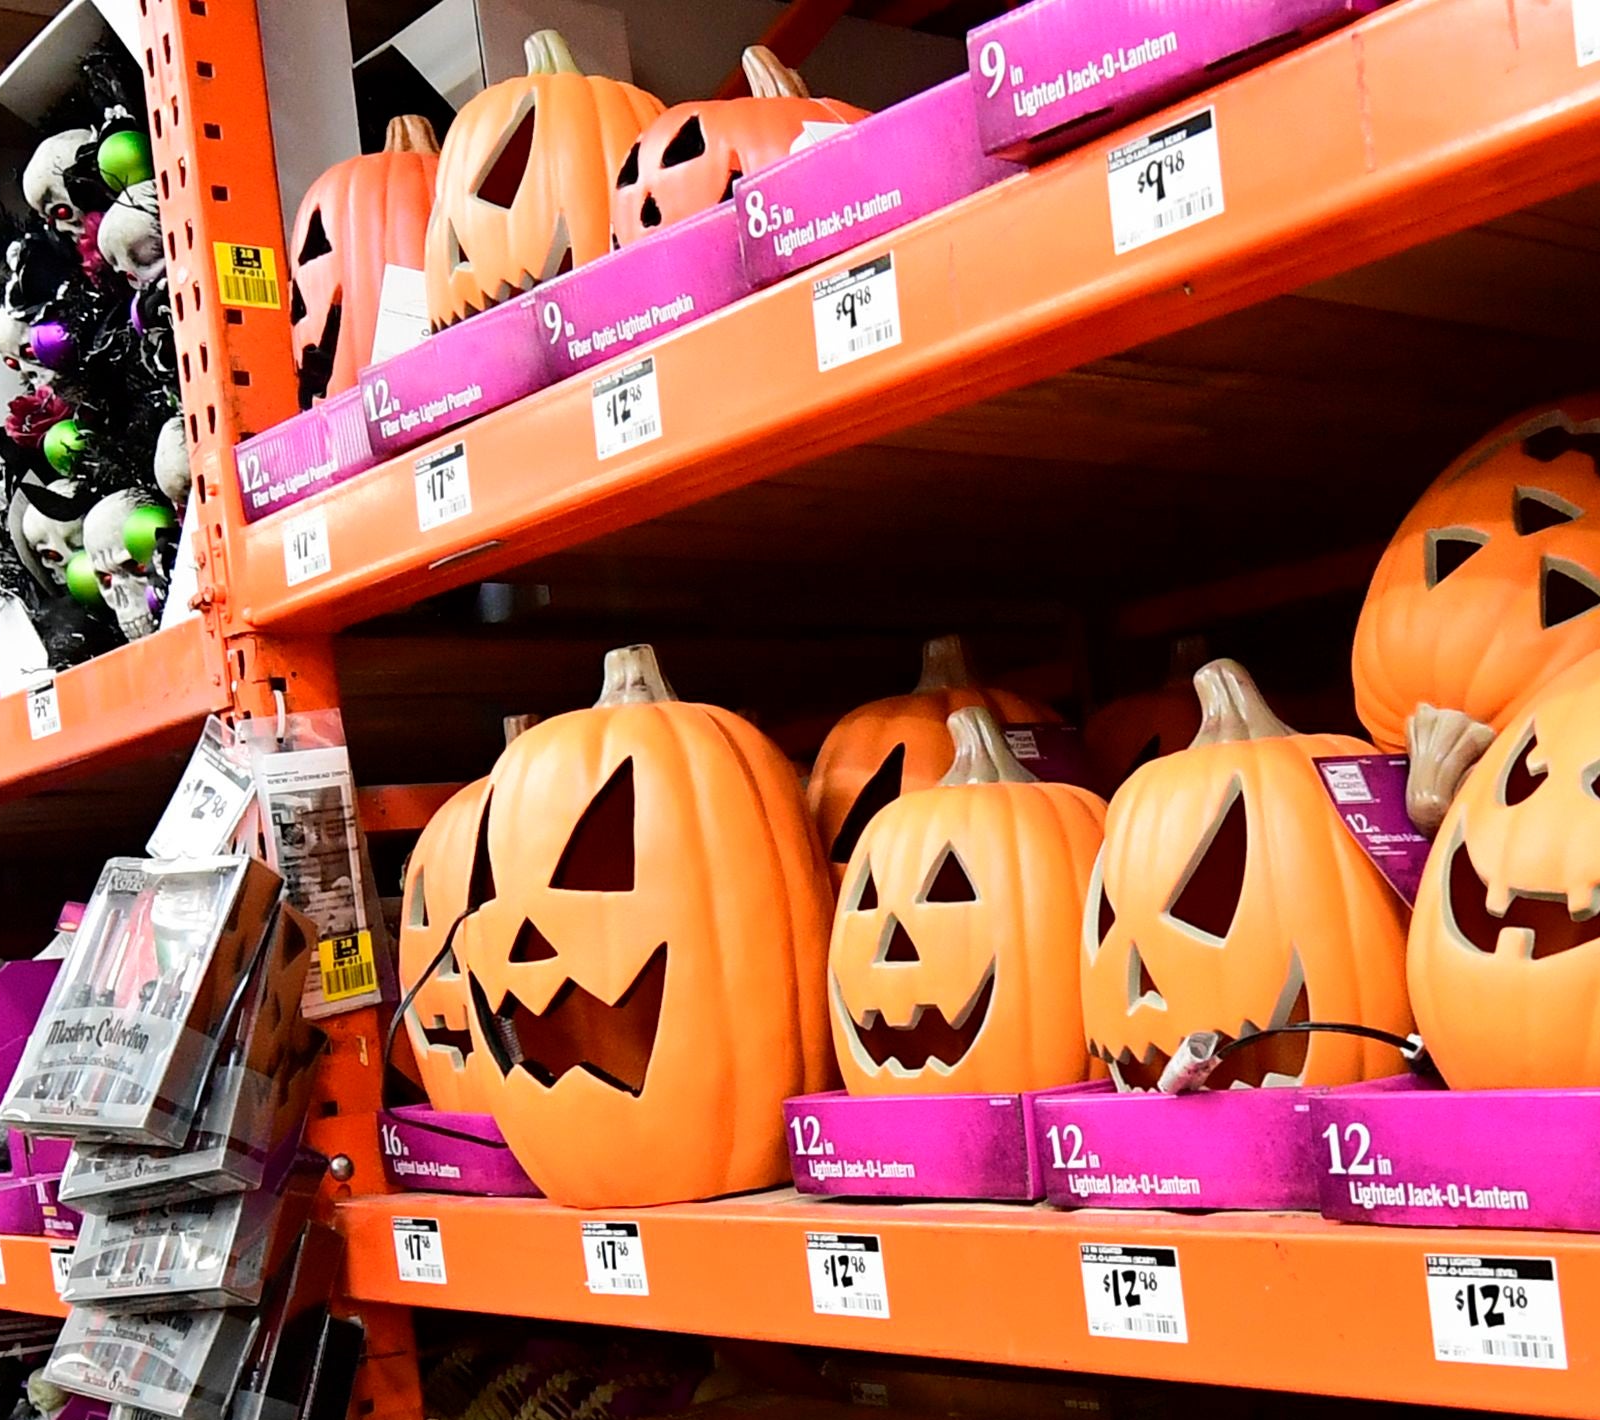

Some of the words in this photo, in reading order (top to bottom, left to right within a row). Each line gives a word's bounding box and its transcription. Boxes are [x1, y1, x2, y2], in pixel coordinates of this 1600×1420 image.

[980, 41, 1006, 98] 9
[1010, 65, 1024, 86] in
[1013, 79, 1066, 117] Lighted
[1067, 31, 1178, 96] Jack-O-Lantern
[774, 227, 815, 257] Lighted
[816, 188, 902, 239] Jack-O-Lantern
[783, 204, 795, 223] in
[543, 301, 562, 345] 9
[568, 335, 593, 361] Fiber
[593, 326, 617, 352] Optic
[616, 310, 651, 344] Lighted
[650, 294, 695, 328] Pumpkin
[363, 379, 393, 422] 12
[419, 398, 448, 425] Lighted
[447, 383, 482, 414] Pumpkin
[239, 453, 263, 493] 12
[45, 1018, 95, 1047] Masters
[96, 1012, 149, 1054] Collection
[381, 1124, 401, 1156] 16
[790, 1115, 824, 1156] 12
[824, 1139, 835, 1155] in
[1046, 1124, 1087, 1169] 12
[1087, 1151, 1100, 1169] in
[1321, 1122, 1375, 1176] 12
[1376, 1154, 1393, 1177] in
[808, 1159, 843, 1182] Lighted
[844, 1160, 916, 1179] Jack-O-Lantern
[1068, 1173, 1111, 1197] Lighted
[1112, 1173, 1200, 1195] Jack-O-Lantern
[1348, 1180, 1406, 1212] Lighted
[1407, 1182, 1529, 1211] Jack-O-Lantern
